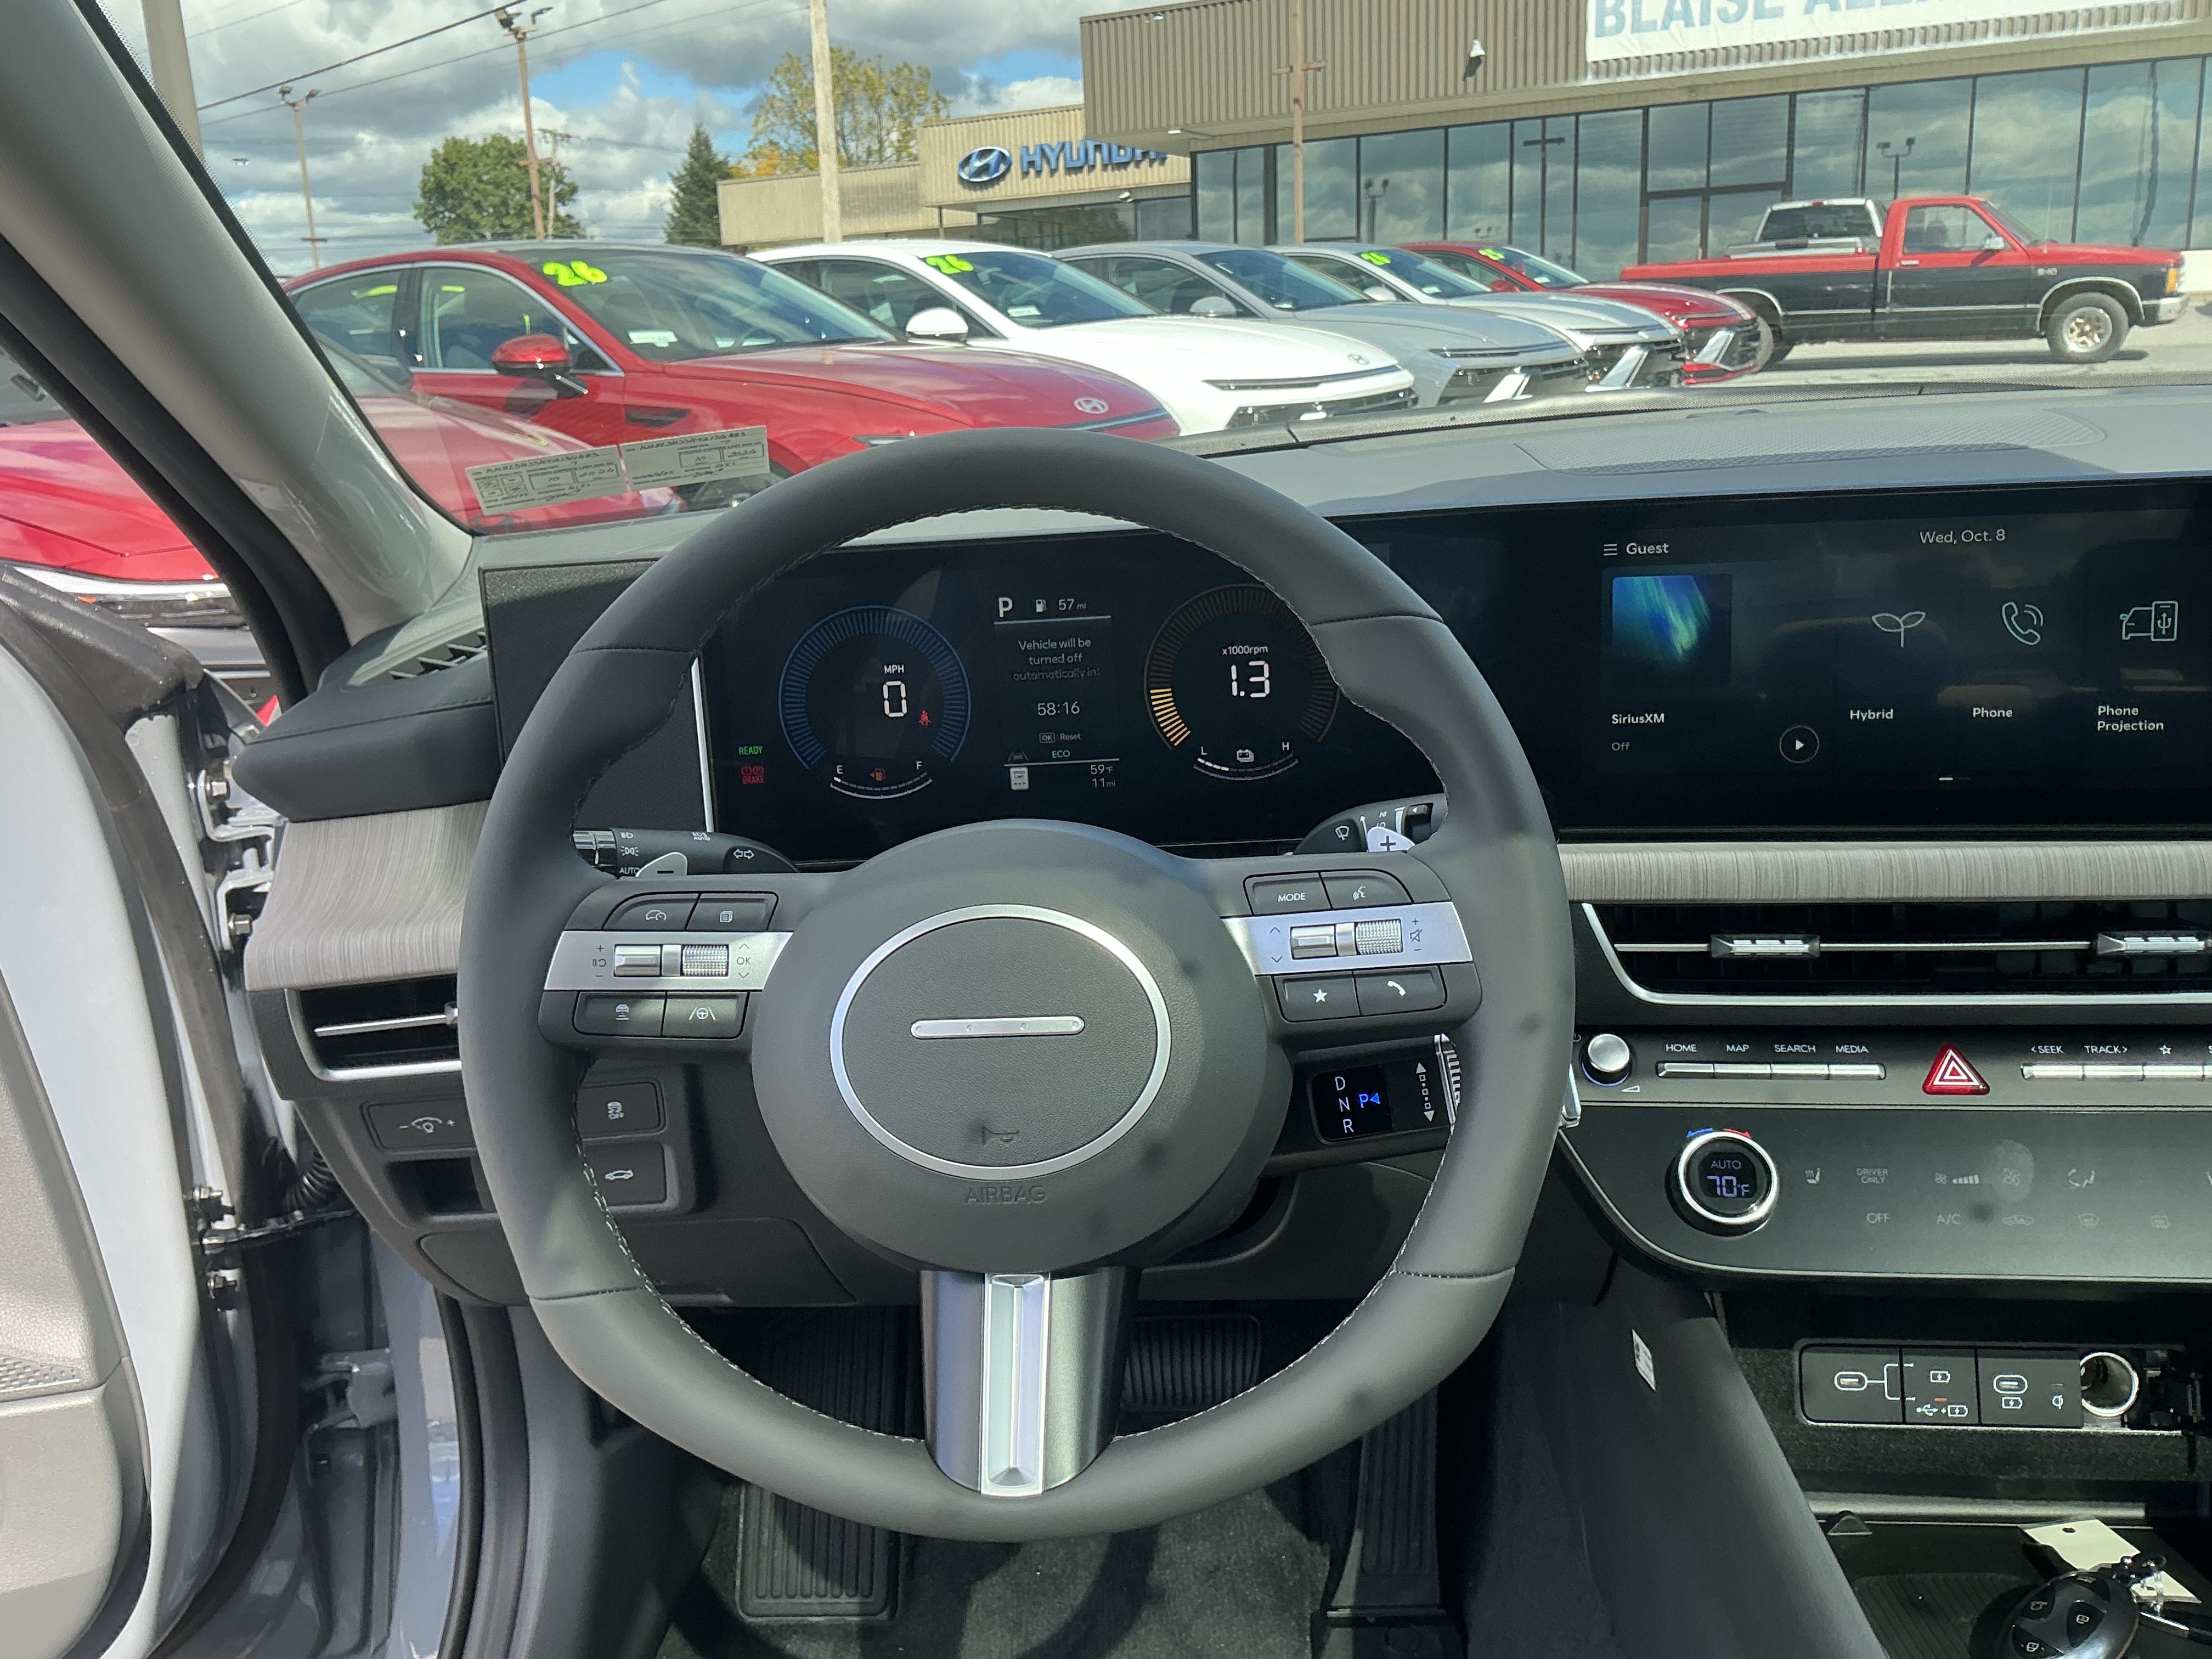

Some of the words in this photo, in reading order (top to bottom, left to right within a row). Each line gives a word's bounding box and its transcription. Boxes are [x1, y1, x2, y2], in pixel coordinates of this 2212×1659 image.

[926, 255, 974, 274] 26
[542, 261, 607, 286] 26
[1920, 530, 1958, 544] Wed,
[1960, 529, 1993, 543] Oct.
[1995, 529, 2006, 541] 8
[1626, 542, 1669, 555] Guest
[998, 597, 1013, 618] P
[1058, 599, 1075, 611] 57
[1018, 639, 1057, 651] Vehicle
[1058, 637, 1076, 648] will
[1077, 637, 1091, 648] be
[1222, 645, 1269, 656] x1000rpm
[1028, 653, 1065, 665] turned
[1066, 652, 1083, 663] off
[884, 664, 904, 674] MPH
[1013, 667, 1086, 682] automatically
[1231, 660, 1271, 698] 1.3
[882, 680, 907, 718] 0
[1037, 701, 1081, 716] 58:16
[1972, 707, 2013, 719] Phone
[2097, 705, 2139, 716] Phone
[1611, 713, 1665, 725] SiriusXM
[1849, 708, 1894, 722] Hybrid
[2097, 719, 2165, 732] Projection
[1059, 732, 1081, 741] Reset
[738, 746, 763, 755] READY
[1200, 746, 1208, 755] L
[1282, 742, 1290, 751] H
[1611, 742, 1631, 752] Off
[1052, 750, 1070, 758] ECO
[837, 765, 843, 775] E
[916, 761, 923, 770] F
[742, 775, 765, 785] BRAKE
[1278, 891, 1306, 902] MODE
[736, 957, 752, 966] OK
[1665, 1043, 1698, 1053] HOME
[1726, 1043, 1750, 1053] MAP
[1774, 1043, 1816, 1053] SEARCH
[1835, 1045, 1870, 1054] MEDIA
[1335, 1076, 1346, 1091] D
[1338, 1097, 1351, 1113] N
[1358, 1093, 1369, 1109] P
[1342, 1118, 1354, 1134] R
[1710, 1159, 1742, 1170] AUTO
[1856, 1167, 1889, 1177] DRIVER
[1861, 1175, 1886, 1185] ONLY
[964, 1185, 1049, 1206] AIRBAG
[1866, 1212, 1891, 1224] OFF
[1936, 1213, 1962, 1226] A/C
